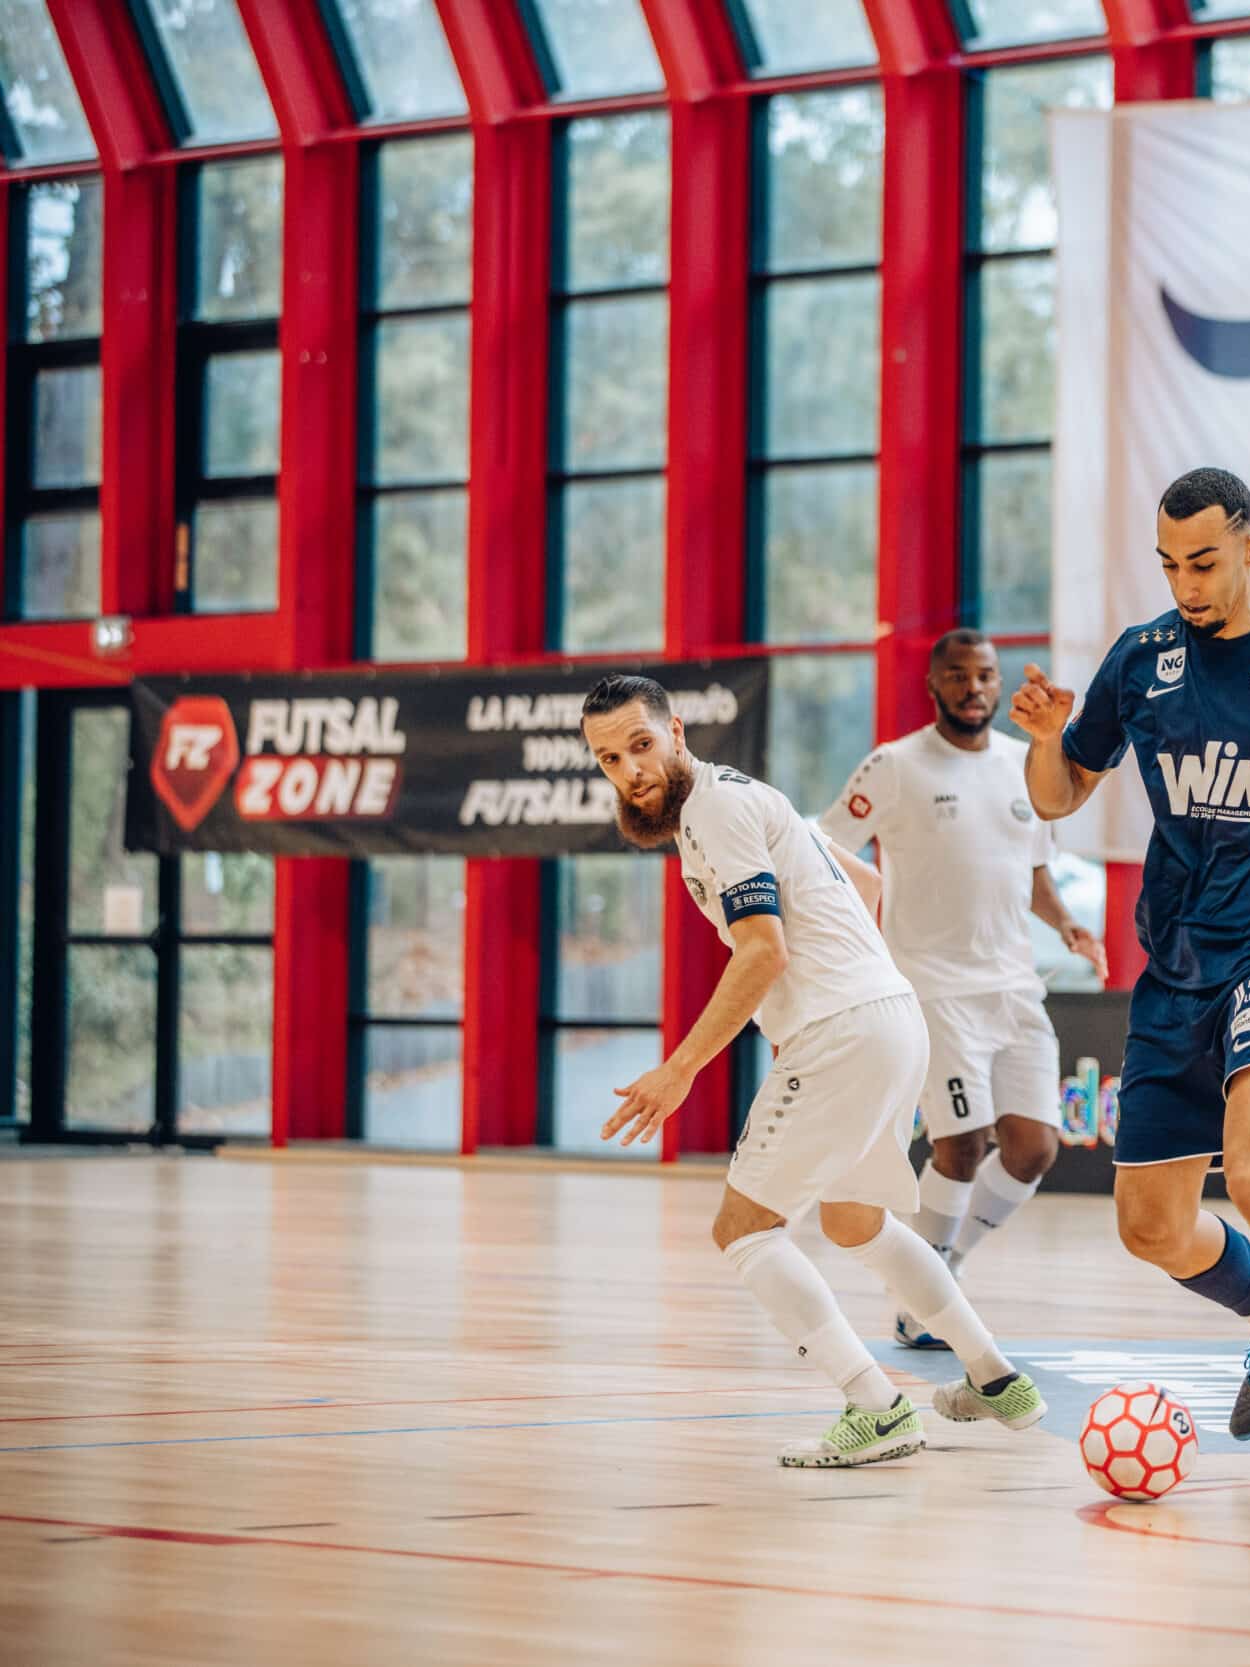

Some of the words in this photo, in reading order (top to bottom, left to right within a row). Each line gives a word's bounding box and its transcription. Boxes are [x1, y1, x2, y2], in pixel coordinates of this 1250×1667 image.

[246, 696, 406, 755] FUTSAL
[465, 695, 503, 731] LA
[166, 724, 223, 770] FZ
[241, 758, 397, 816] ZONE
[947, 1077, 969, 1119] 6
